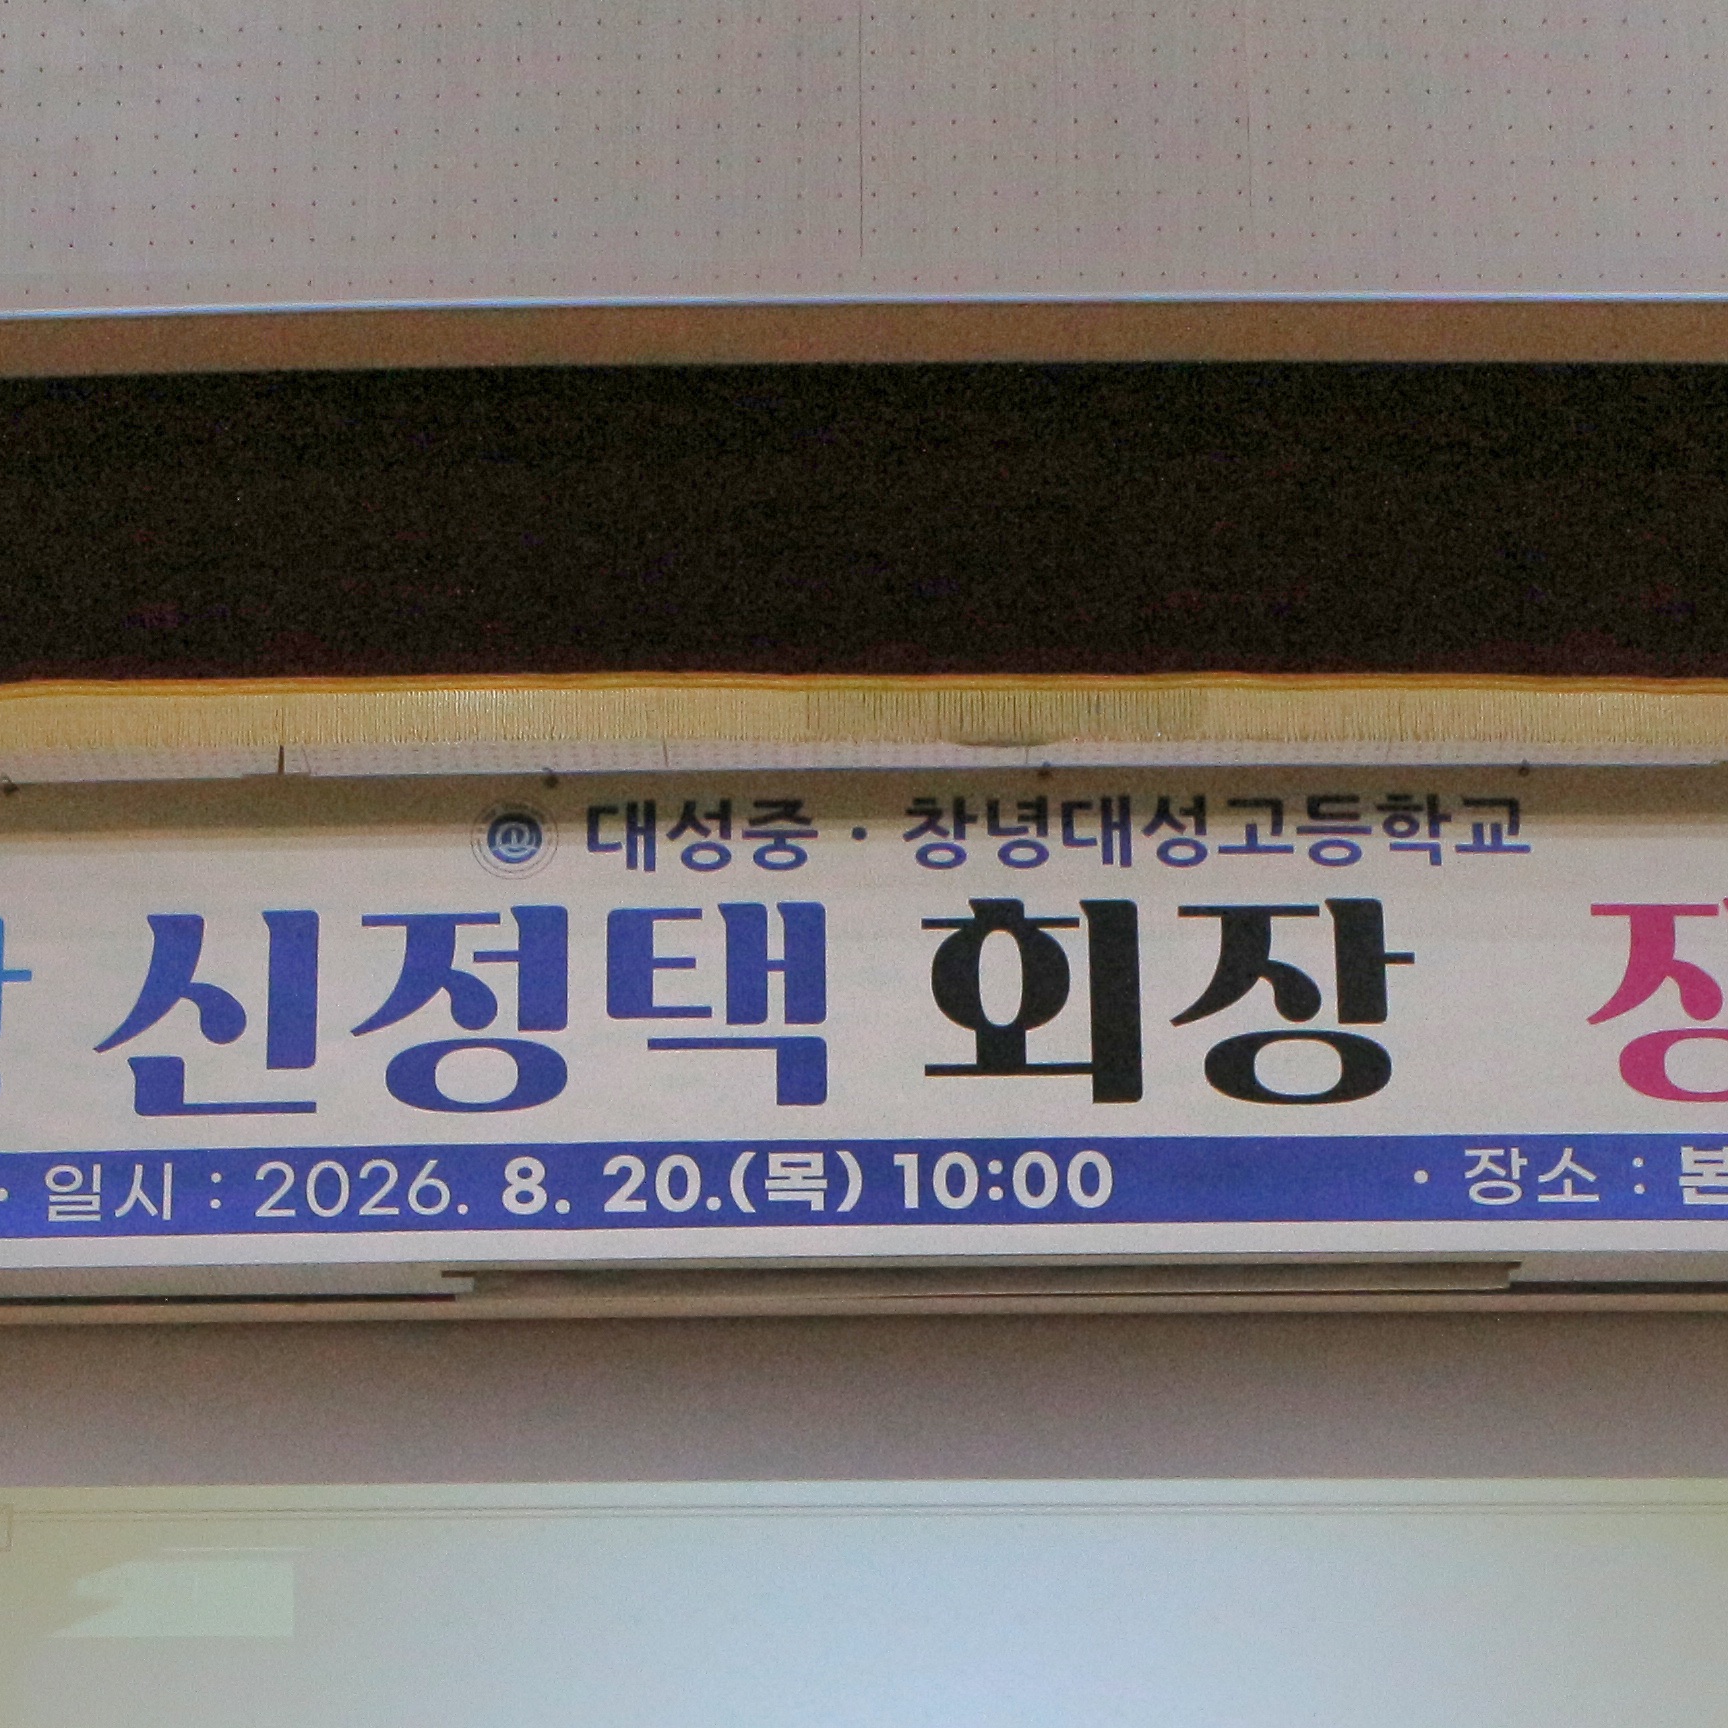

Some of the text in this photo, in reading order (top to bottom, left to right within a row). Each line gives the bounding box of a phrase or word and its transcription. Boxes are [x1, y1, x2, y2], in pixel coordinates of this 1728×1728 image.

[586, 798, 819, 872] 대성중
[902, 794, 1532, 870] 창녕대성고등학교
[97, 900, 827, 1115] 신정택
[922, 898, 1414, 1106] 회장
[45, 1162, 172, 1222] 일시
[255, 1159, 469, 1217] 2026.
[502, 1156, 570, 1215] 8.
[603, 1151, 862, 1214] 20.(목)
[894, 1150, 1113, 1211] 10:00
[1465, 1147, 1600, 1205] 장소
